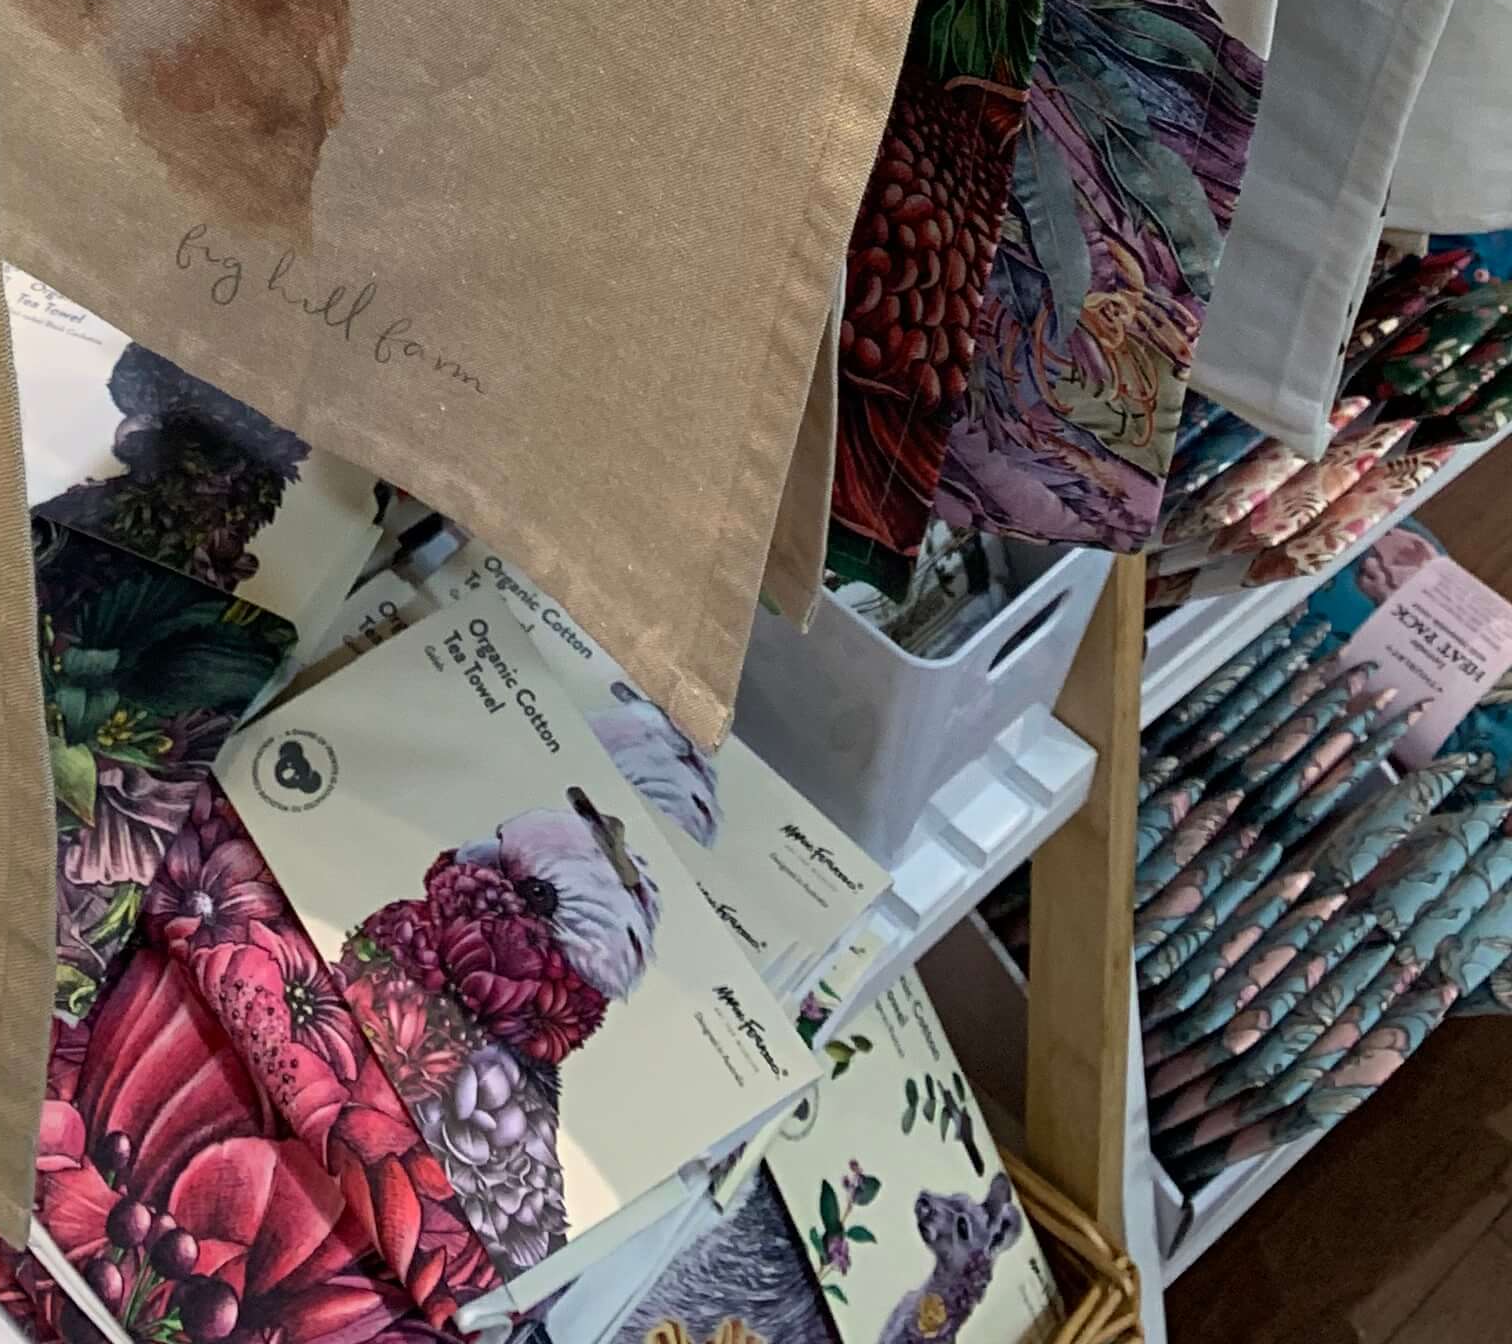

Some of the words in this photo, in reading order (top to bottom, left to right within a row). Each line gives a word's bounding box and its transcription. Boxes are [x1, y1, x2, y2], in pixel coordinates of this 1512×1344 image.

[464, 569, 482, 591] Te
[484, 555, 541, 612] Organic
[541, 608, 594, 660] Cotton
[1391, 603, 1439, 644] PACK
[443, 630, 467, 664] Tea
[464, 660, 507, 714] Towel
[469, 618, 519, 689] Organic
[515, 689, 561, 754] Cotton
[1438, 641, 1486, 683] HEAT
